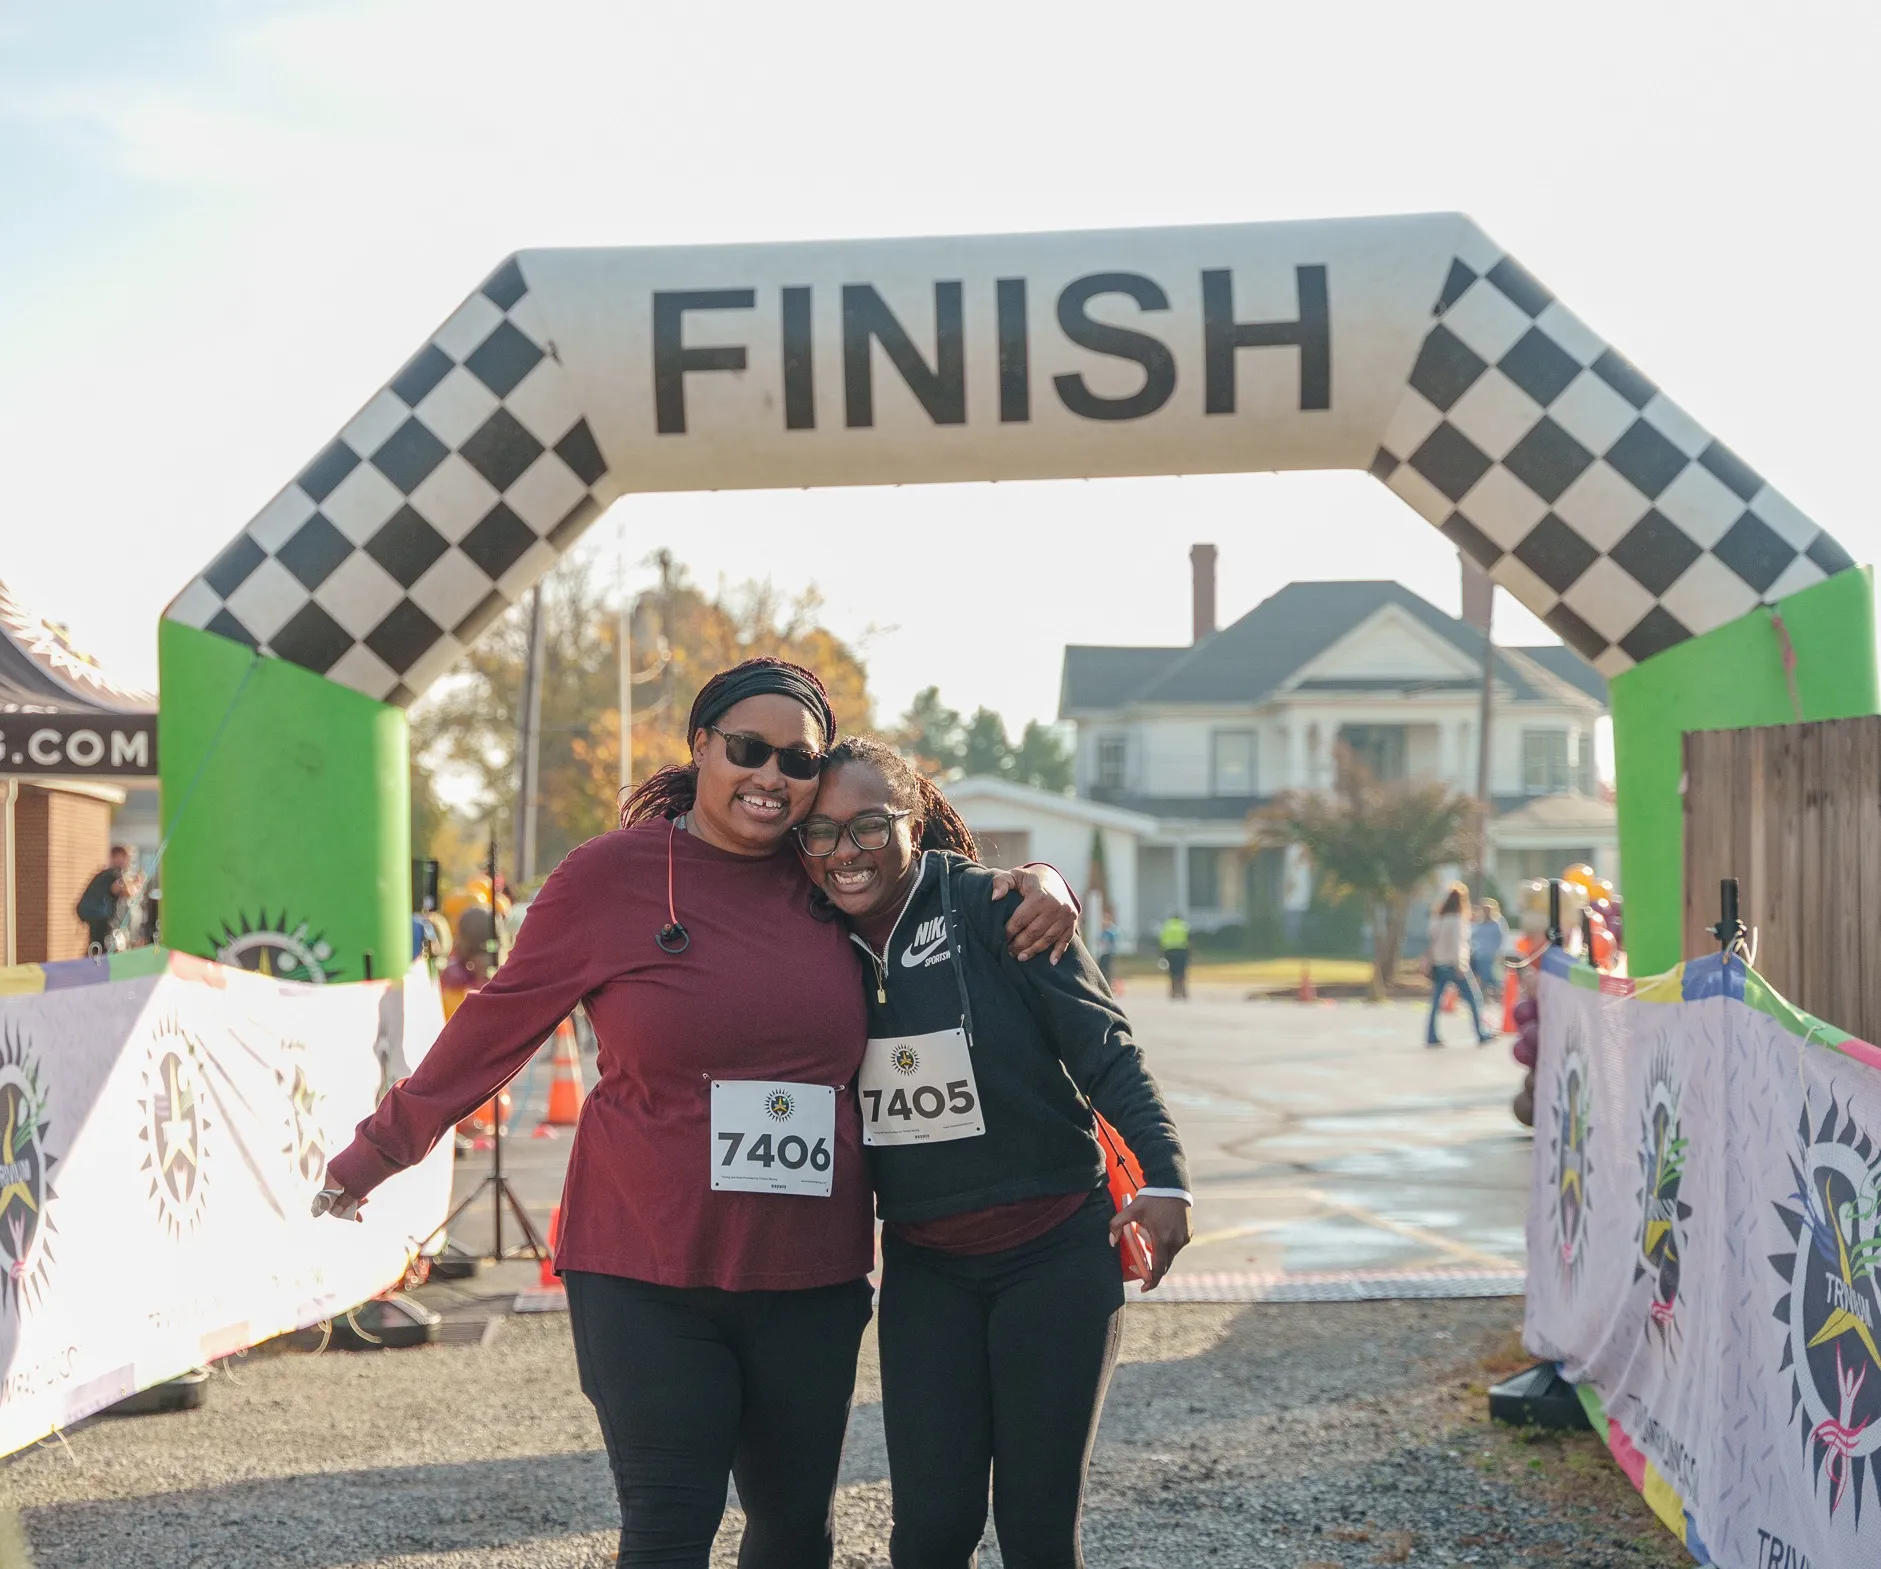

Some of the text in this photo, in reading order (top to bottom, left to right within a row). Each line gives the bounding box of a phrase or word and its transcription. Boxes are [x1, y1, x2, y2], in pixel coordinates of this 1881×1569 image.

[652, 264, 1330, 434] FINISH
[0, 728, 149, 768] .COM
[863, 1079, 975, 1123] 7405
[718, 1132, 831, 1172] 7406
